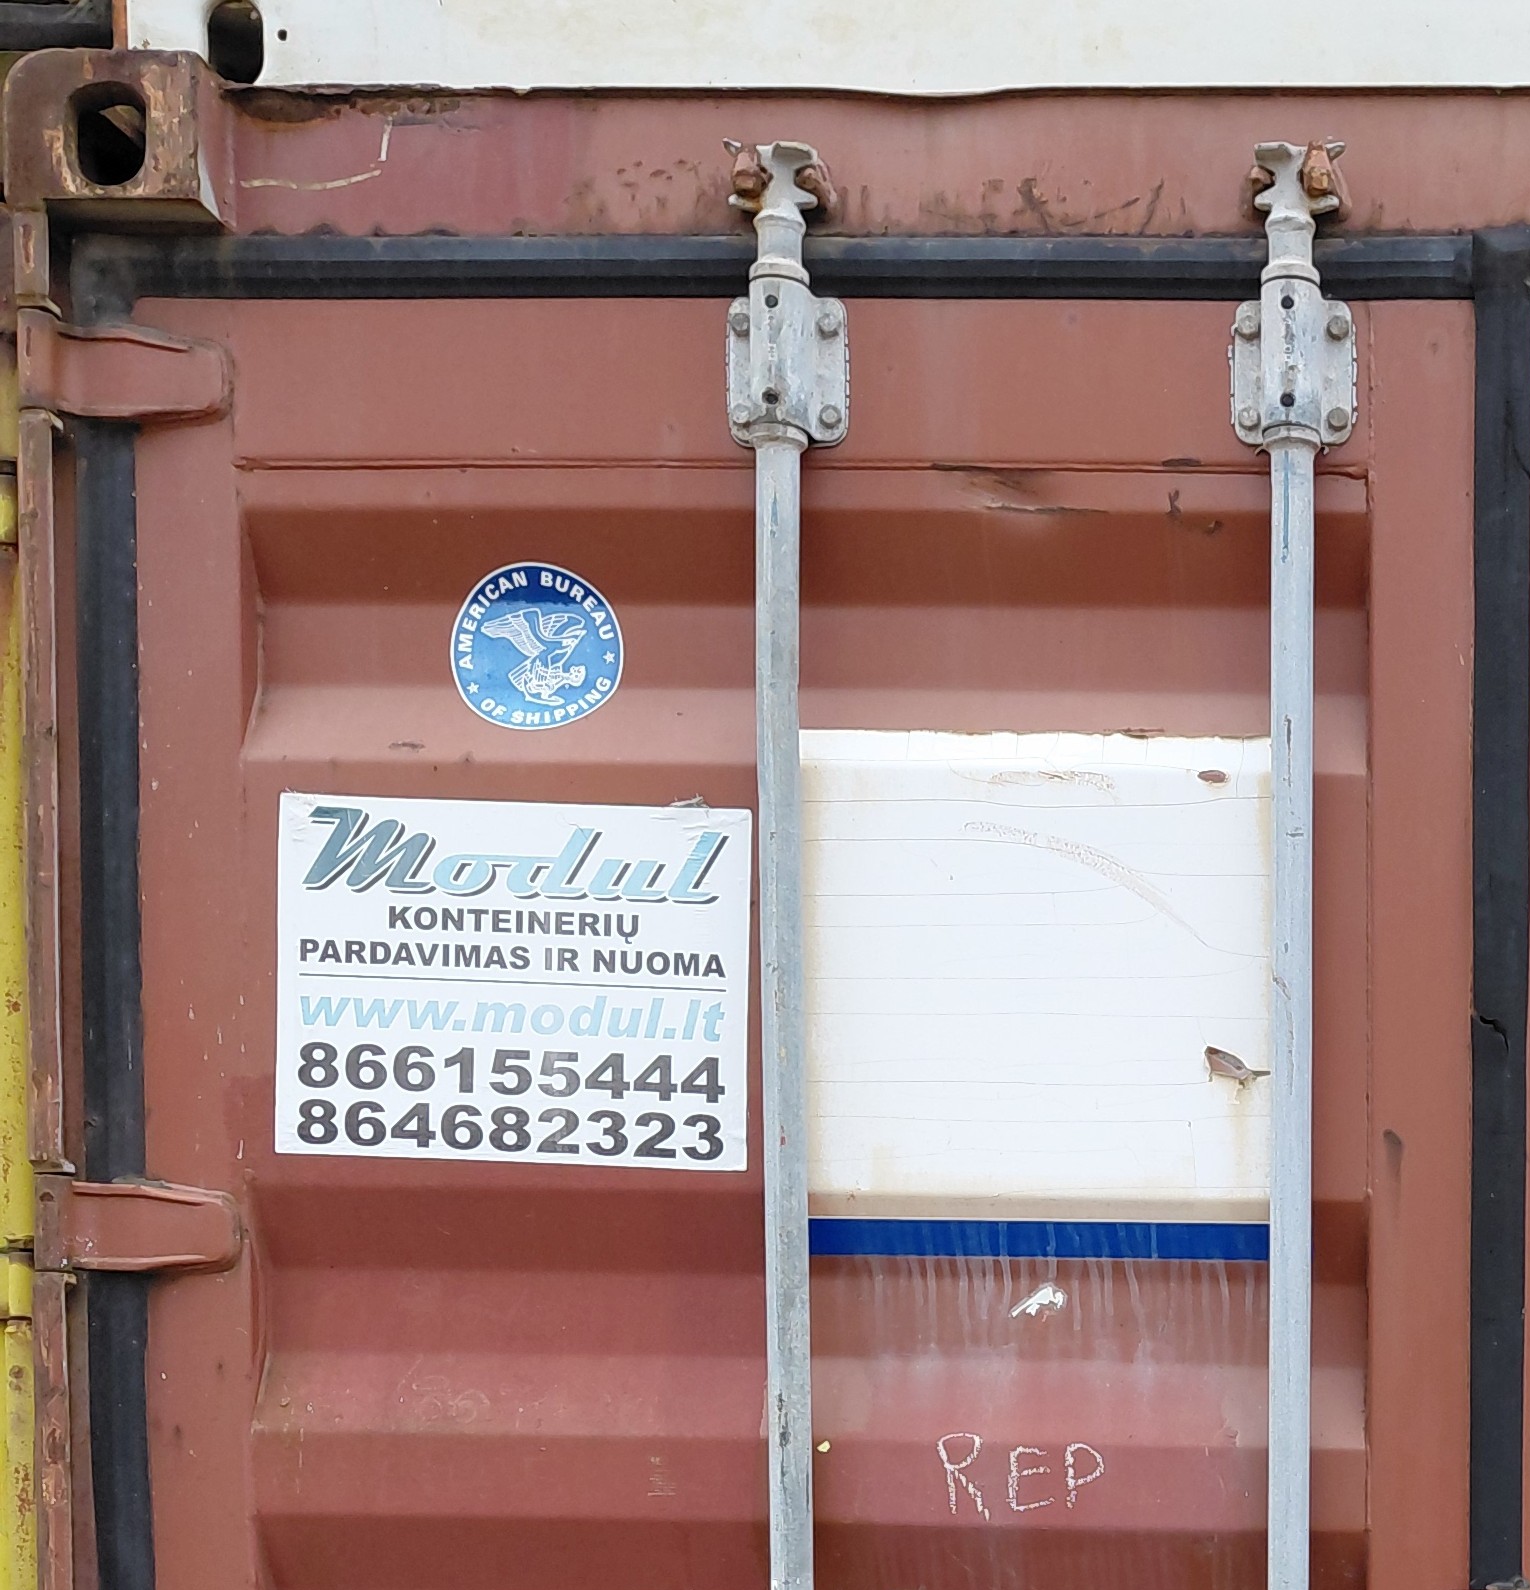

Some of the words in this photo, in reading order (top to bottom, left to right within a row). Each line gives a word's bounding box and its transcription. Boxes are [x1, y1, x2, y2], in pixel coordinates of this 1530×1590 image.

[457, 570, 529, 671] AMERICAN
[539, 570, 616, 641] BUREAU
[479, 697, 508, 718] OF
[510, 675, 612, 725] SHIPPING
[301, 805, 730, 905] Modul
[387, 904, 640, 945] KONTEINERIŲ
[299, 938, 531, 971] PARDAVIMAS
[543, 946, 579, 973] IR
[592, 949, 727, 979] NUOMA
[299, 994, 726, 1043] www.modul.lt
[297, 1041, 726, 1105] 866155444
[296, 1100, 725, 1161] 864682323
[935, 1432, 1105, 1522] REP
